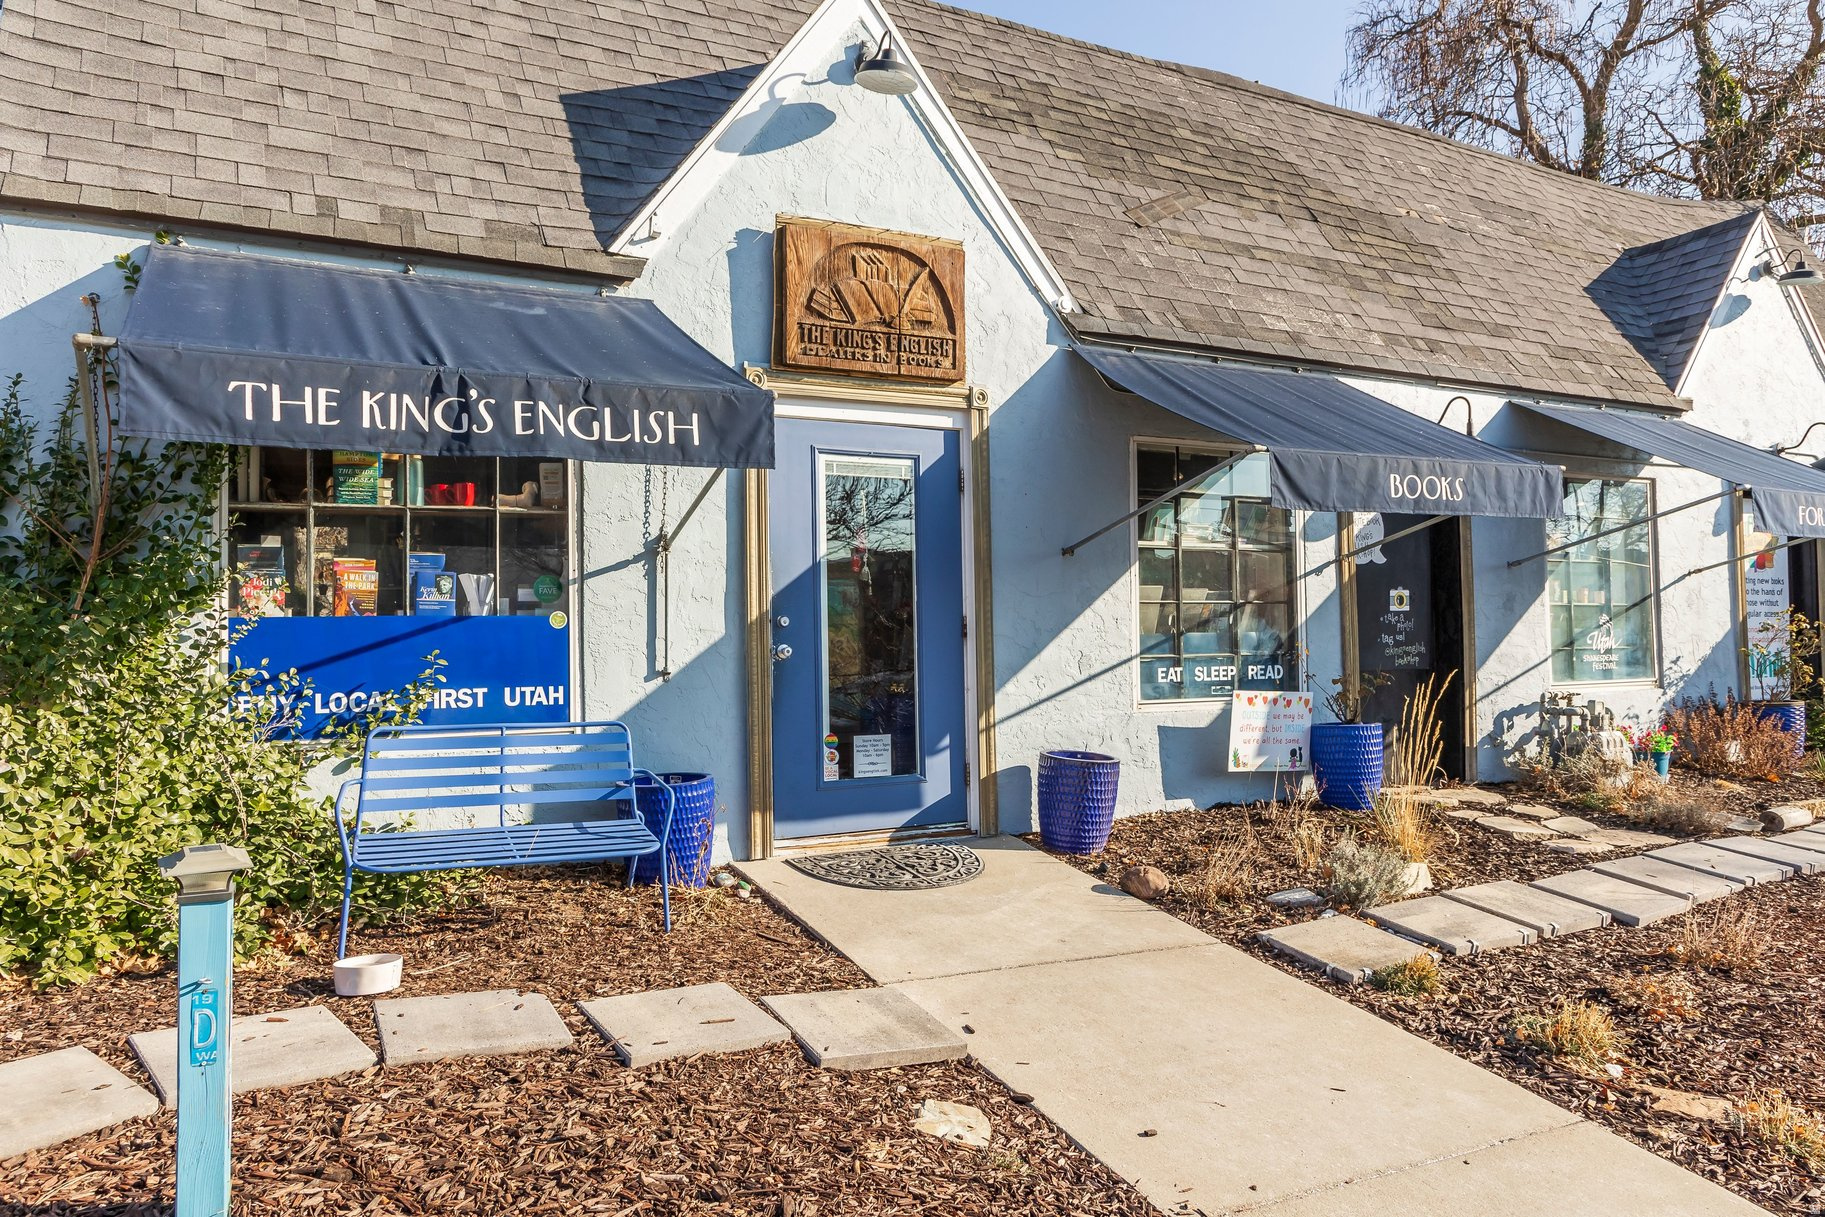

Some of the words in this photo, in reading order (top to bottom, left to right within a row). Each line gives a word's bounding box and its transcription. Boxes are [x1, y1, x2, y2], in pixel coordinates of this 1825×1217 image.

[803, 324, 829, 345] THE
[836, 329, 884, 350] KING'S
[891, 335, 951, 358] ENGLISH
[901, 353, 944, 368] BOOKS
[227, 380, 341, 426] THE
[362, 388, 496, 434] KING'S
[513, 399, 701, 446] ENGLISH
[1389, 473, 1464, 501] BOOKS
[1798, 505, 1825, 527] FOR
[343, 573, 348, 581] A
[350, 573, 367, 581] WALK
[345, 581, 357, 589] THE
[358, 582, 375, 590] PARK
[539, 587, 558, 595] FAVE
[1751, 588, 1760, 596] the
[1776, 588, 1784, 596] of
[1382, 632, 1394, 646] tag
[1586, 630, 1623, 654] Utah
[1157, 667, 1184, 683] EAT
[1194, 665, 1237, 682] SLEEP
[1247, 664, 1284, 680] READ
[504, 685, 564, 707] UTAH
[1242, 710, 1270, 720] OUTSIDE
[1282, 713, 1295, 723] may
[1296, 711, 1304, 720] be
[1271, 724, 1283, 733] but
[1284, 723, 1305, 734] INSIDE
[1243, 736, 1260, 745] we're
[1261, 737, 1271, 745] all
[1272, 736, 1283, 745] the
[192, 993, 213, 1006] 19
[193, 1008, 217, 1050] D
